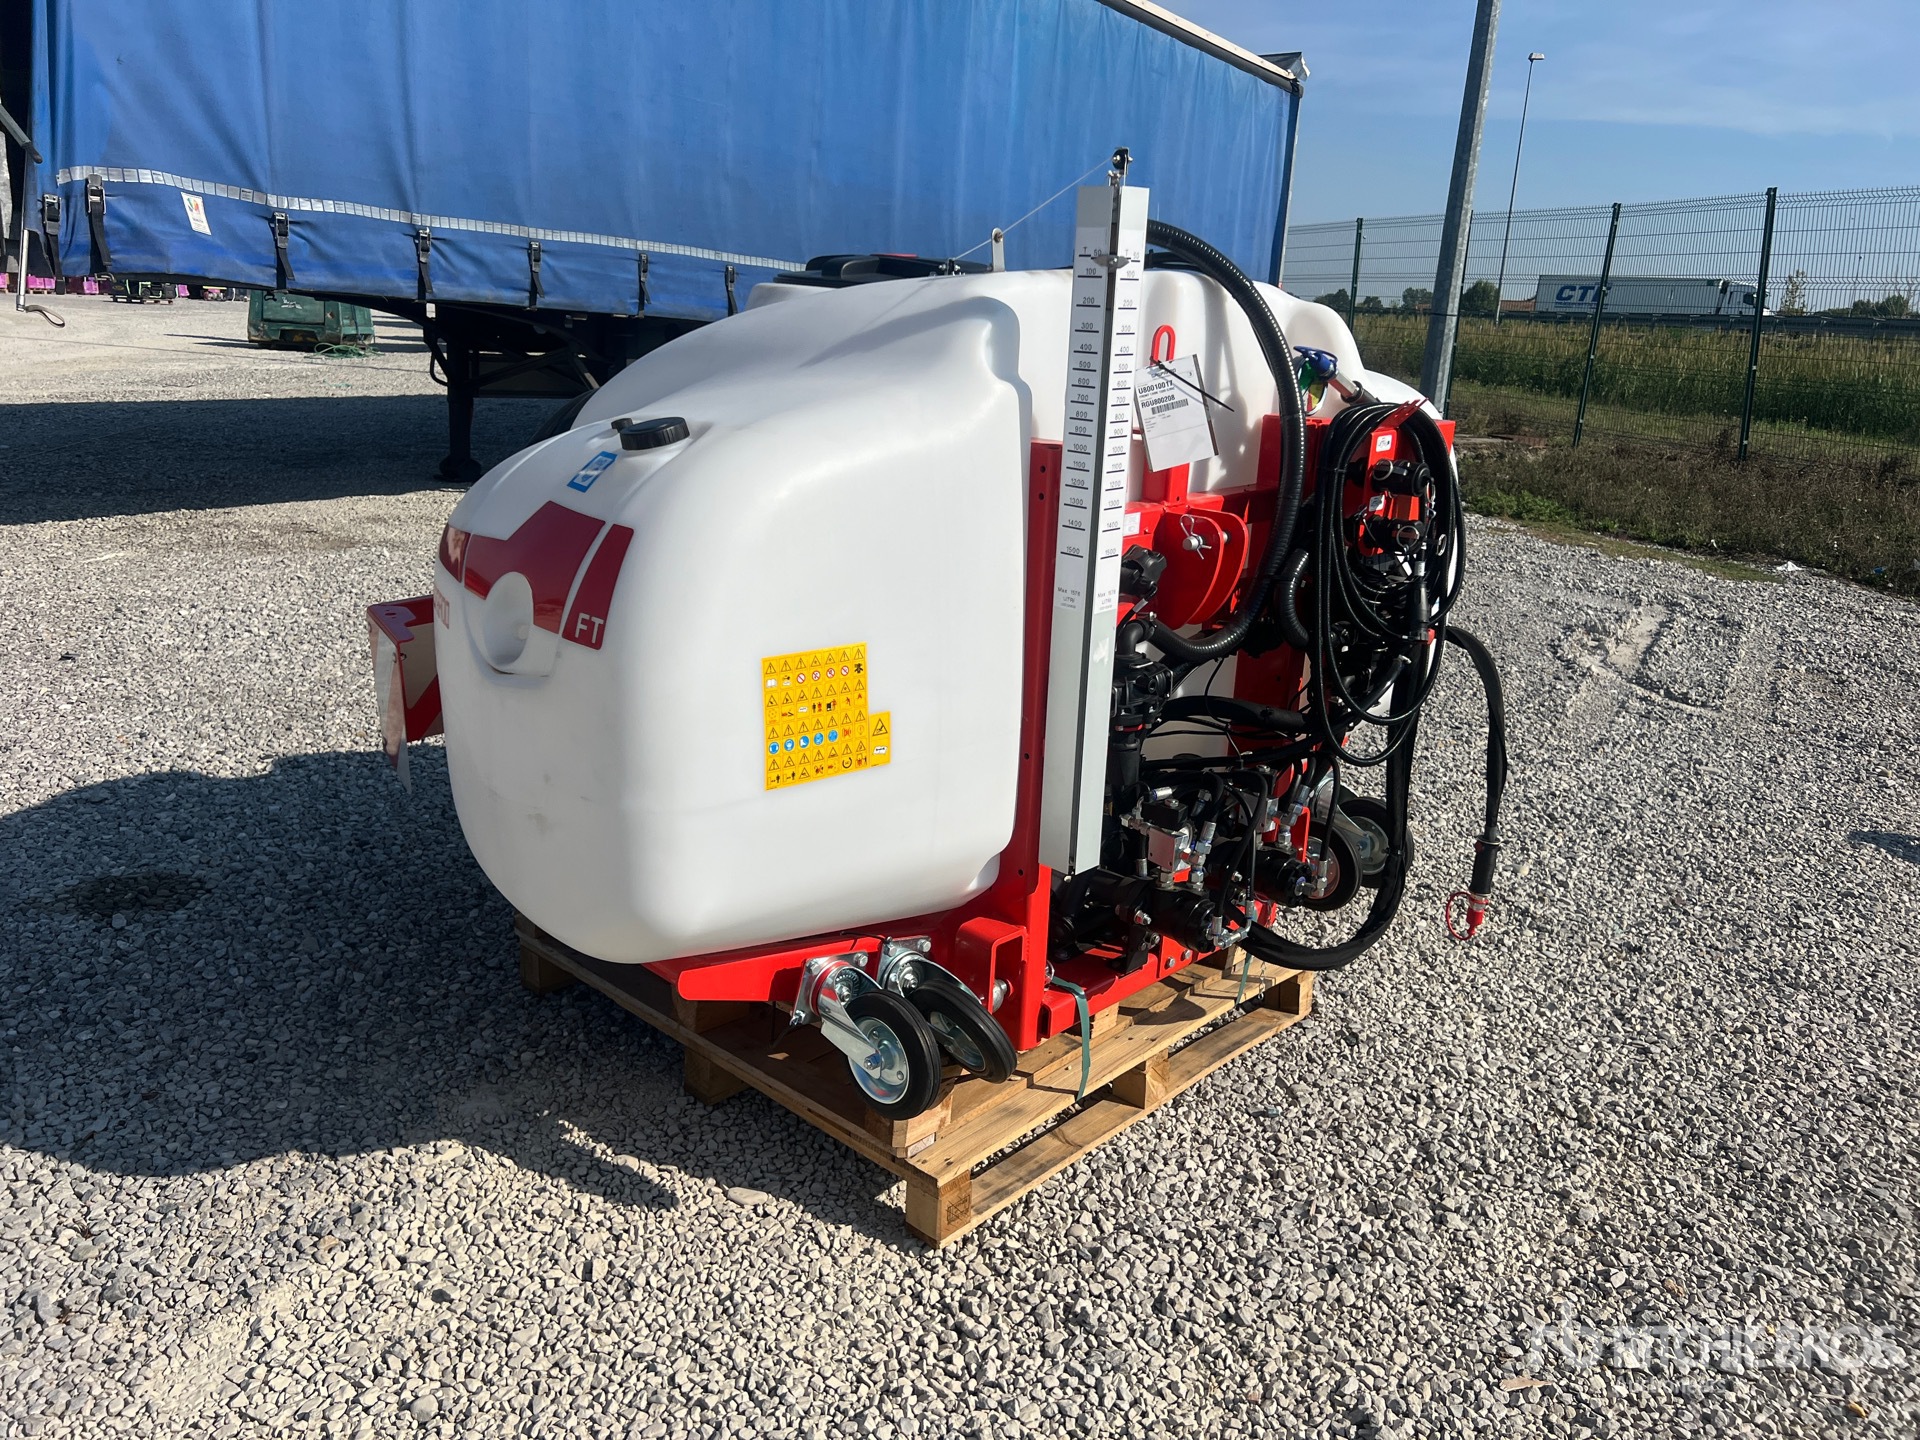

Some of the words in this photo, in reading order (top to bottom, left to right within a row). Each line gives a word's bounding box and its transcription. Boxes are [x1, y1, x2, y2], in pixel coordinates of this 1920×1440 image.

[1086, 268, 1096, 276] 100
[1082, 296, 1095, 304] 200
[1081, 322, 1094, 330] 300
[1078, 360, 1091, 368] 500
[1078, 378, 1090, 386] 600
[1116, 396, 1126, 404] 700
[1076, 410, 1088, 418] 800
[1073, 443, 1087, 451] 1000
[1073, 460, 1086, 468] 1100
[1071, 478, 1085, 486] 1200
[1109, 480, 1121, 488] 1200
[1069, 497, 1084, 505] 1300
[1108, 499, 1120, 507] 1300
[1068, 519, 1082, 527] 1400
[1066, 546, 1080, 554] 1500
[575, 612, 604, 644] FT
